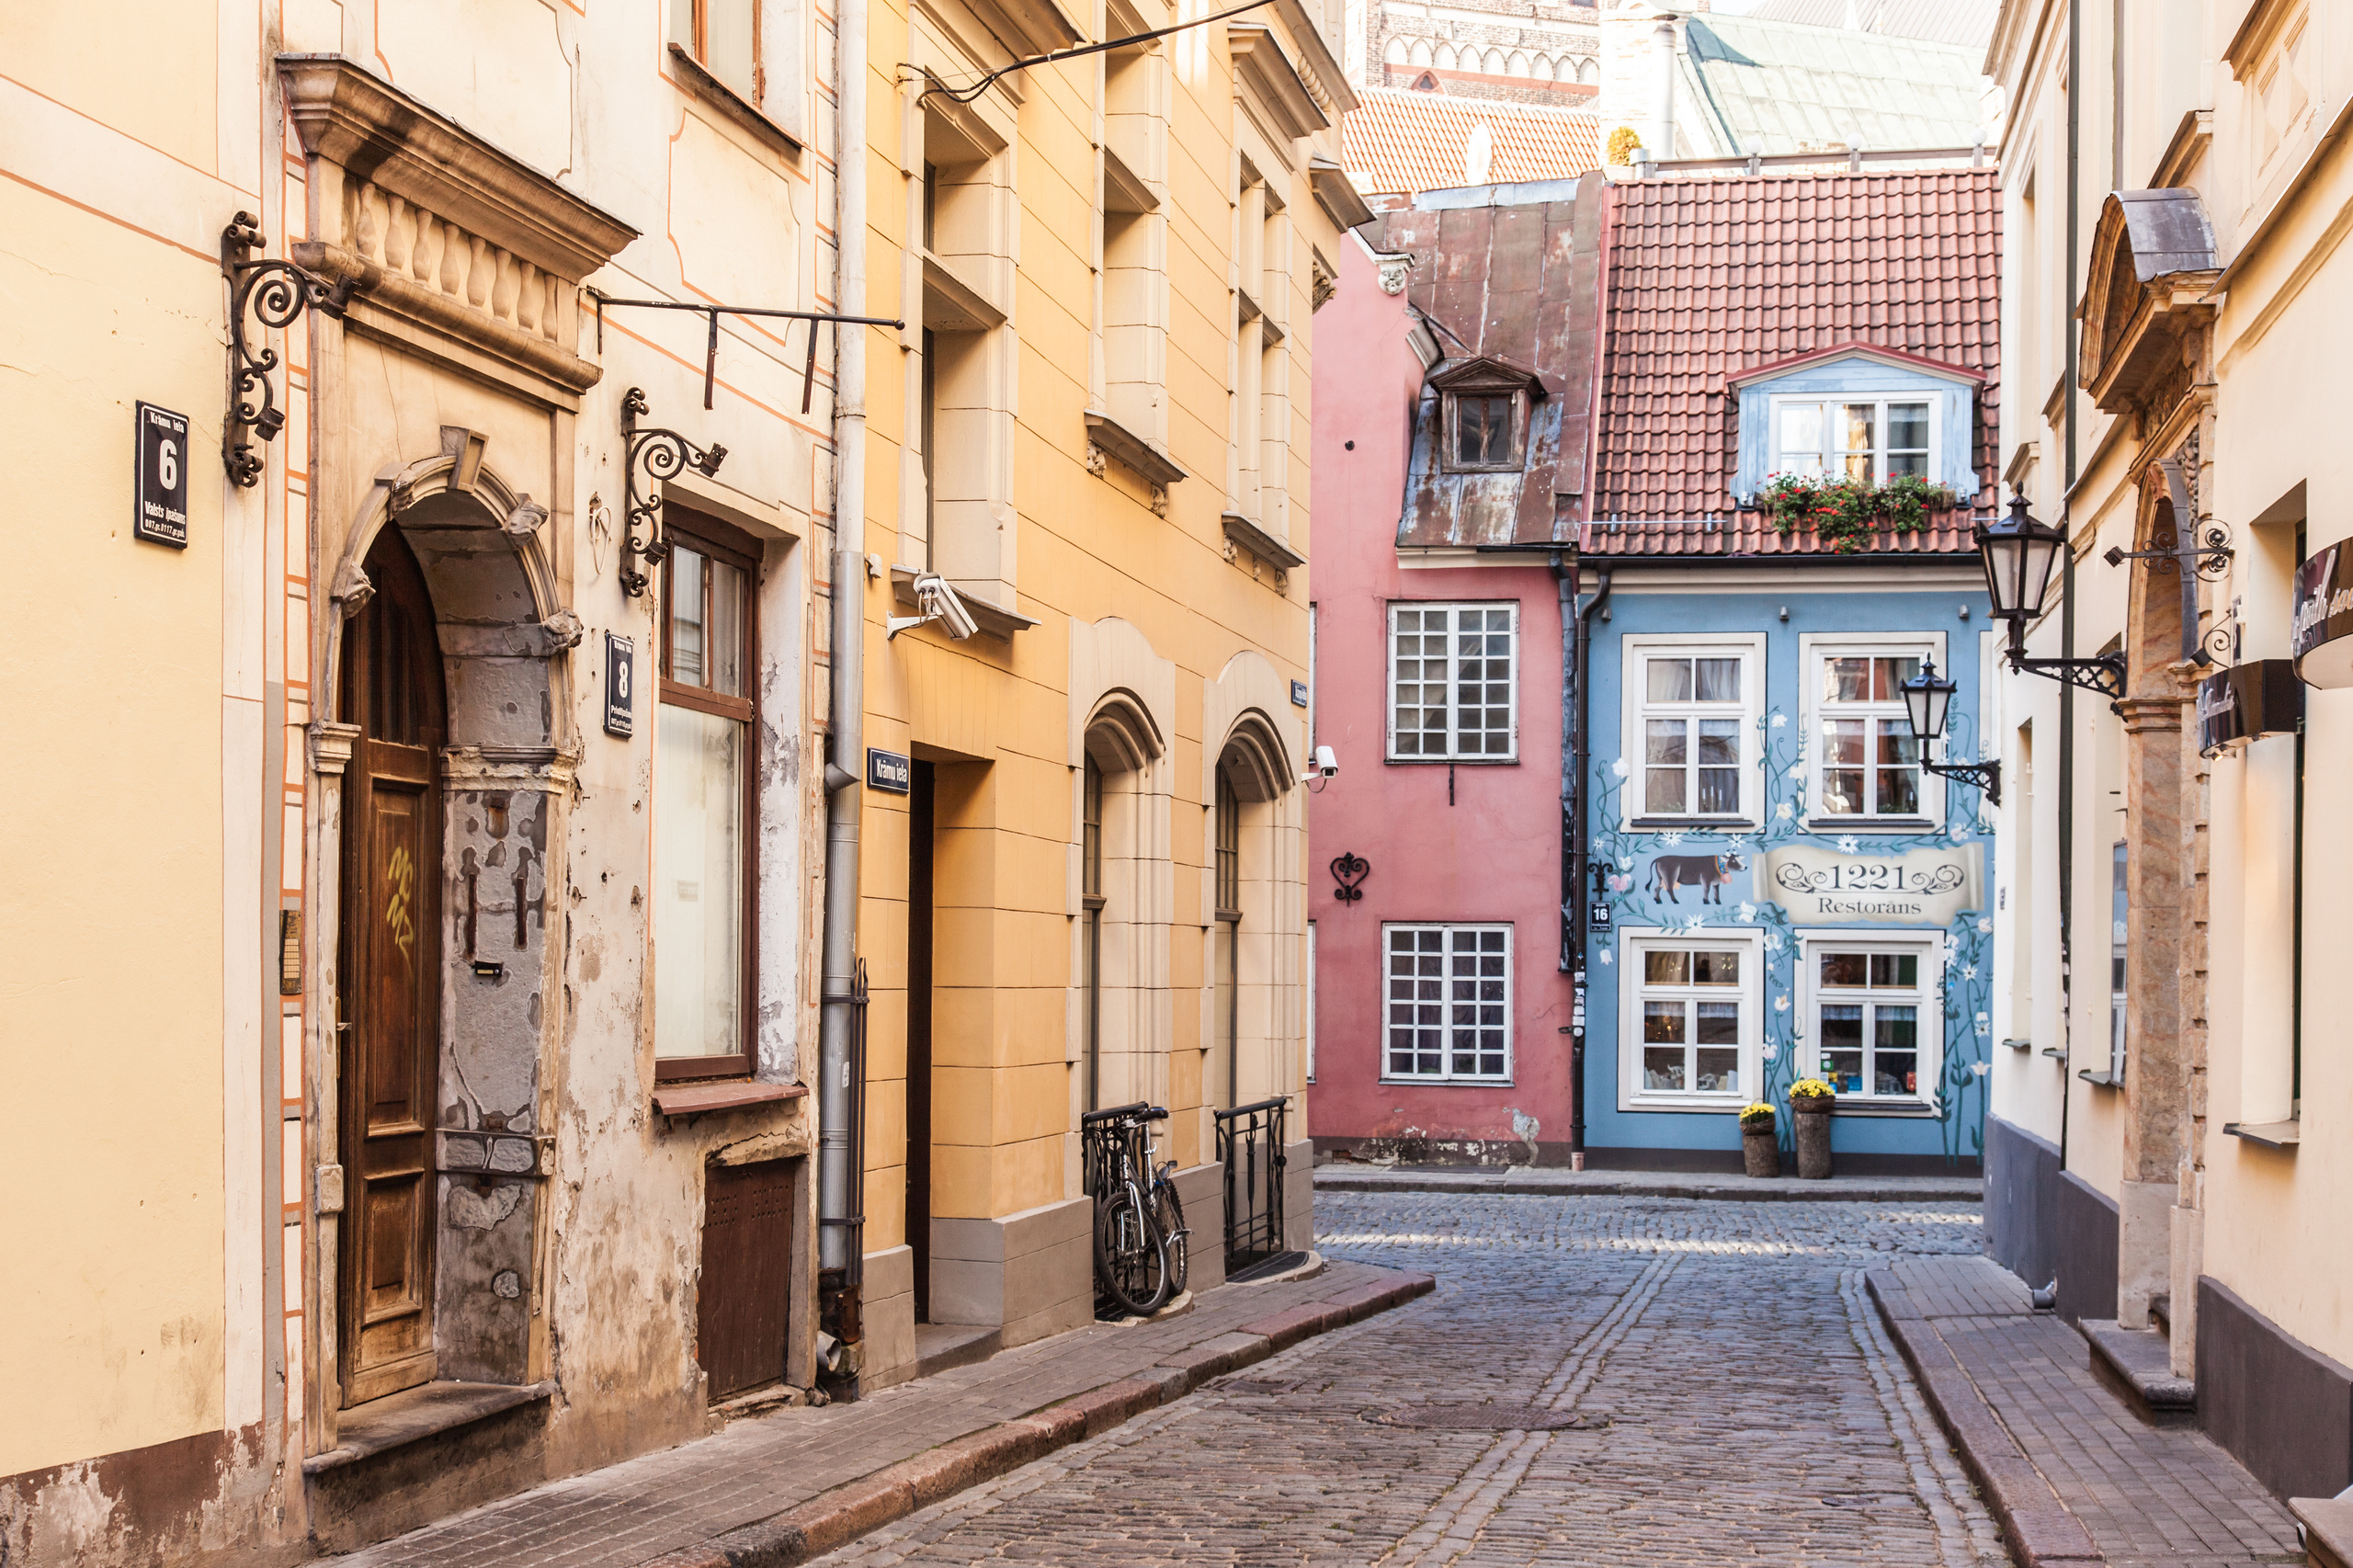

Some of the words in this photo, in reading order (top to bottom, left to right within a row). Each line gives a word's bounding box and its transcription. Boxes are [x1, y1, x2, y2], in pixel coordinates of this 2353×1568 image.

[173, 419, 184, 433] iela
[159, 438, 177, 491] 6
[144, 500, 165, 517] Valsts
[619, 661, 628, 698] 8
[877, 758, 895, 780] Krāmu
[896, 763, 907, 782] iela
[1829, 864, 1909, 891] 1221
[1593, 908, 1608, 921] 16
[1817, 897, 1922, 915] Restorāns
